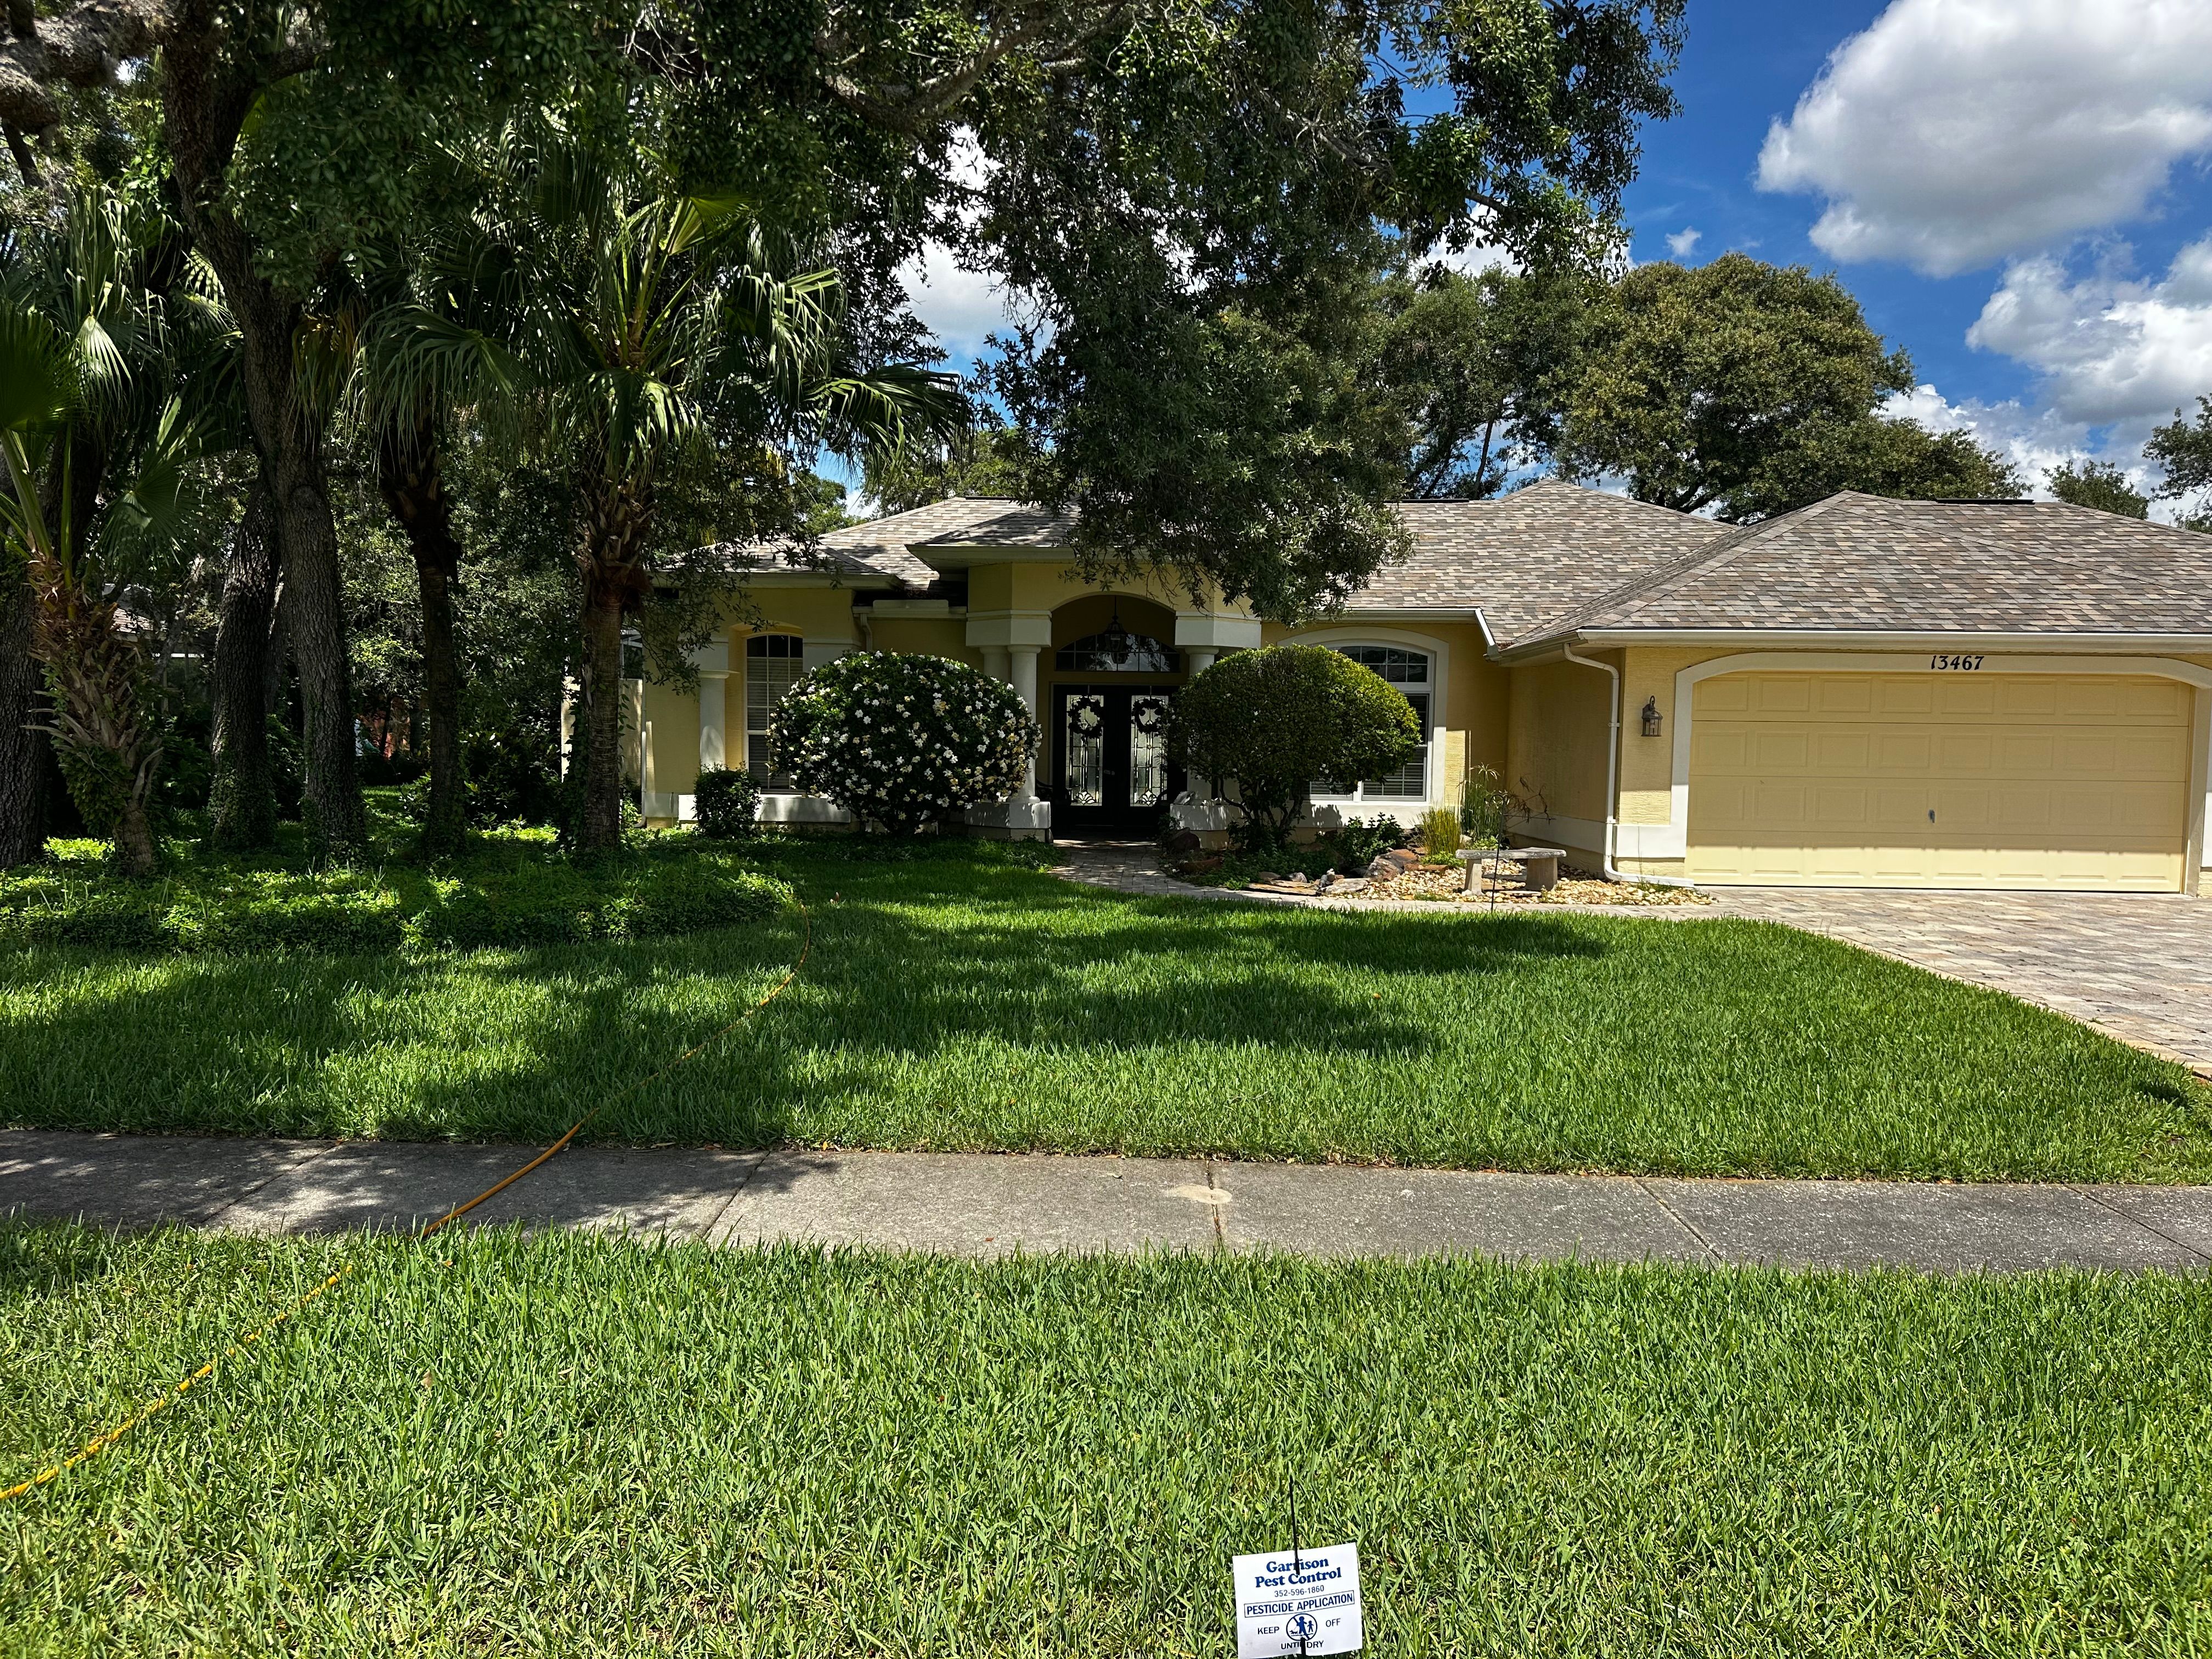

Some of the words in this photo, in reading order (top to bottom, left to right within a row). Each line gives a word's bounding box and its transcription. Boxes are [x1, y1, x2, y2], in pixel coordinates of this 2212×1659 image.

[1931, 655, 1984, 670] 13467
[1255, 1576, 1285, 1588] Pest
[1288, 1567, 1341, 1584] Control
[1274, 1584, 1324, 1597] 352-596-1860
[1247, 1602, 1294, 1615] PESTICIDE
[1297, 1593, 1353, 1611] APPLICATION
[1257, 1626, 1279, 1634] KEEP
[1325, 1618, 1341, 1627] OFF
